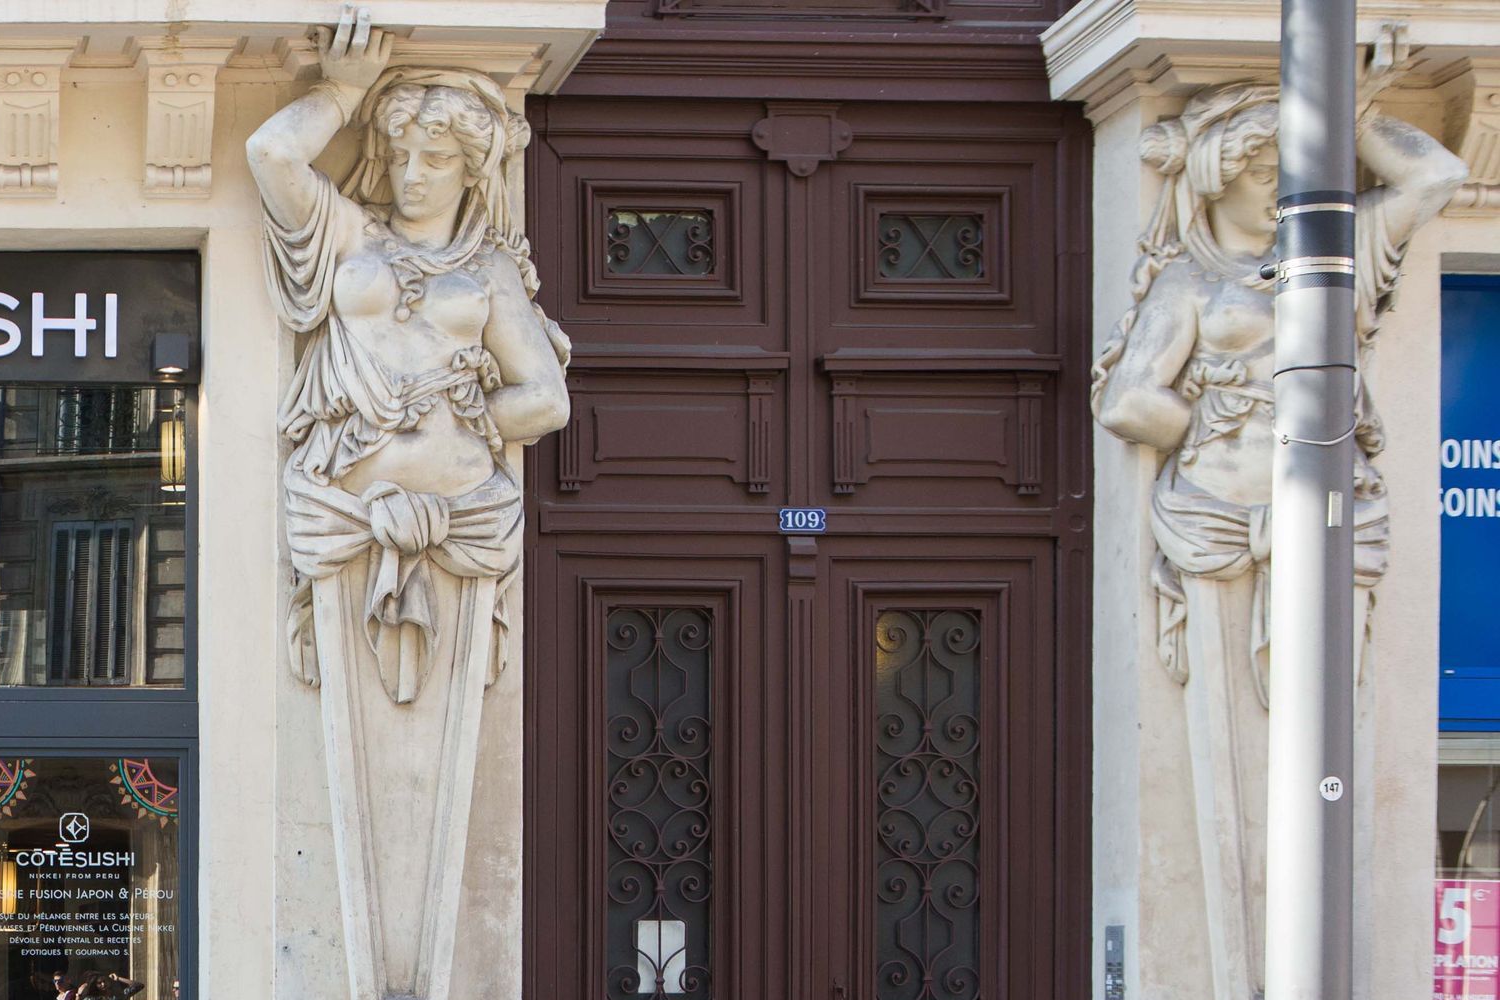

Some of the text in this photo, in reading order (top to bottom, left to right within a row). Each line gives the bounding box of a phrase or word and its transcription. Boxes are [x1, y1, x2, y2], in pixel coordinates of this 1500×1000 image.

[1439, 487, 1500, 518] OIN
[785, 511, 820, 528] 109
[1323, 782, 1340, 793] 147
[29, 889, 72, 900] FUSION
[76, 887, 114, 900] JAPON
[118, 887, 129, 900] &
[33, 911, 72, 920] MÉLANGE
[112, 923, 145, 932] CUISNE
[9, 935, 40, 944] DÉVOILE
[57, 935, 91, 944] ÉVENTAIL
